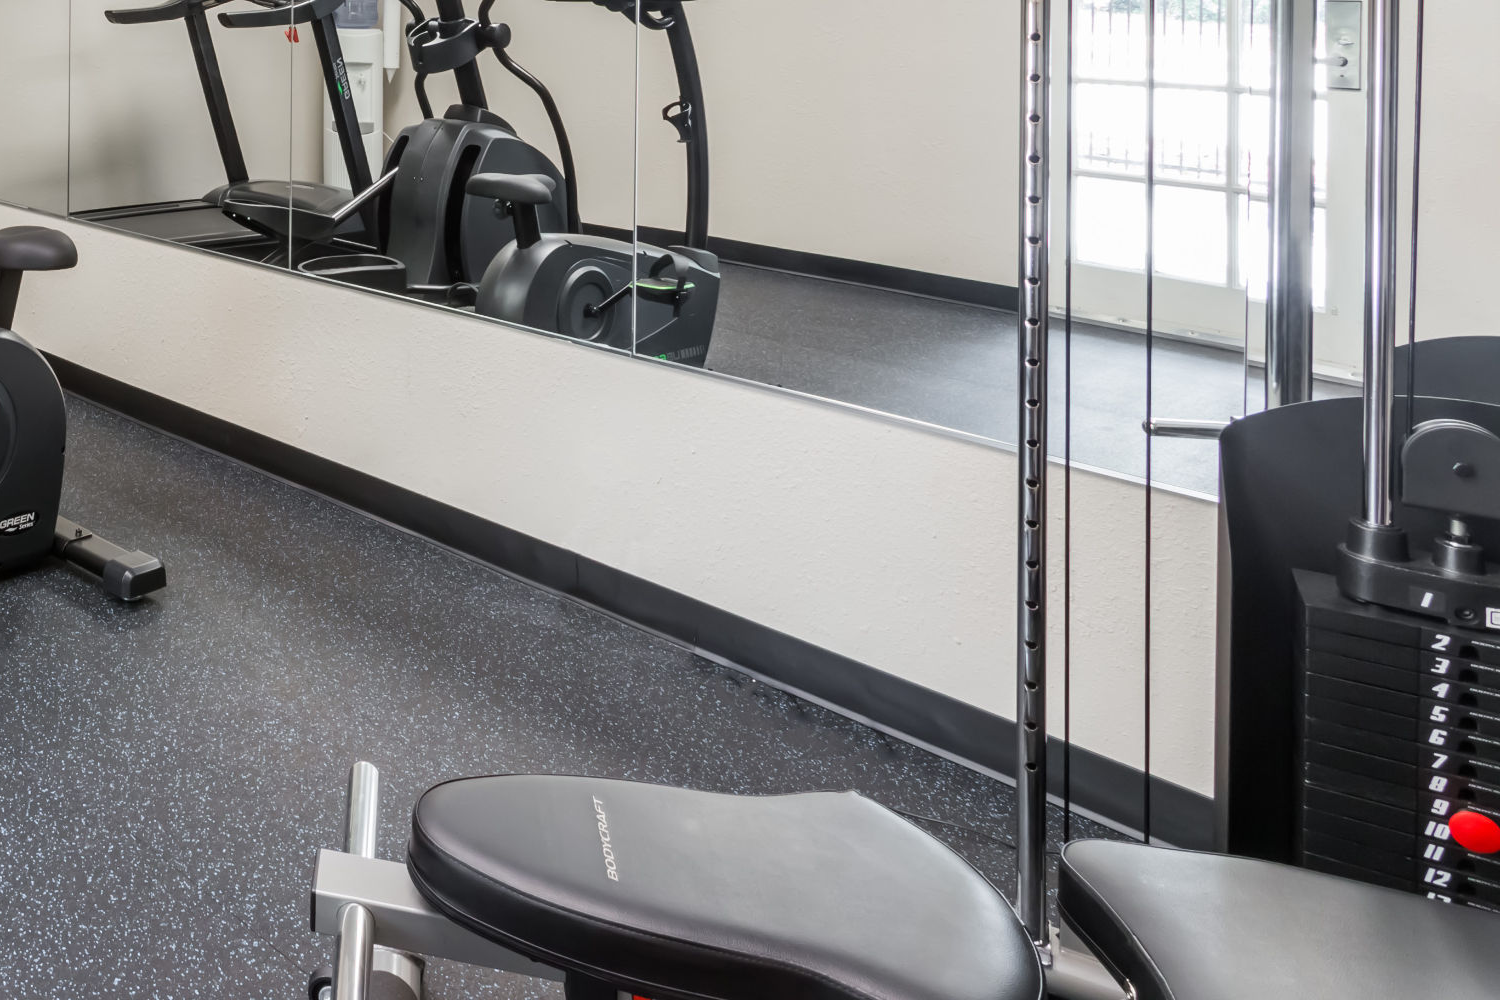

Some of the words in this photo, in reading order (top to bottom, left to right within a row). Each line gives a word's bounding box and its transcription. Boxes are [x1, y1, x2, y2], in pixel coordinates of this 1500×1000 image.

[0, 511, 36, 530] GREEN
[1420, 591, 1434, 608] 1
[1430, 633, 1451, 651] 2
[1430, 657, 1451, 674] 3
[1431, 682, 1450, 699] 4
[1429, 705, 1450, 723] 5
[1428, 728, 1449, 746] 6
[1431, 752, 1449, 769] 7
[1428, 775, 1449, 793] 8
[1430, 798, 1450, 816] 9
[592, 794, 619, 882] BODYCRAFT
[1424, 820, 1452, 841] 10
[1423, 843, 1445, 861] 11
[1424, 867, 1452, 888] 12
